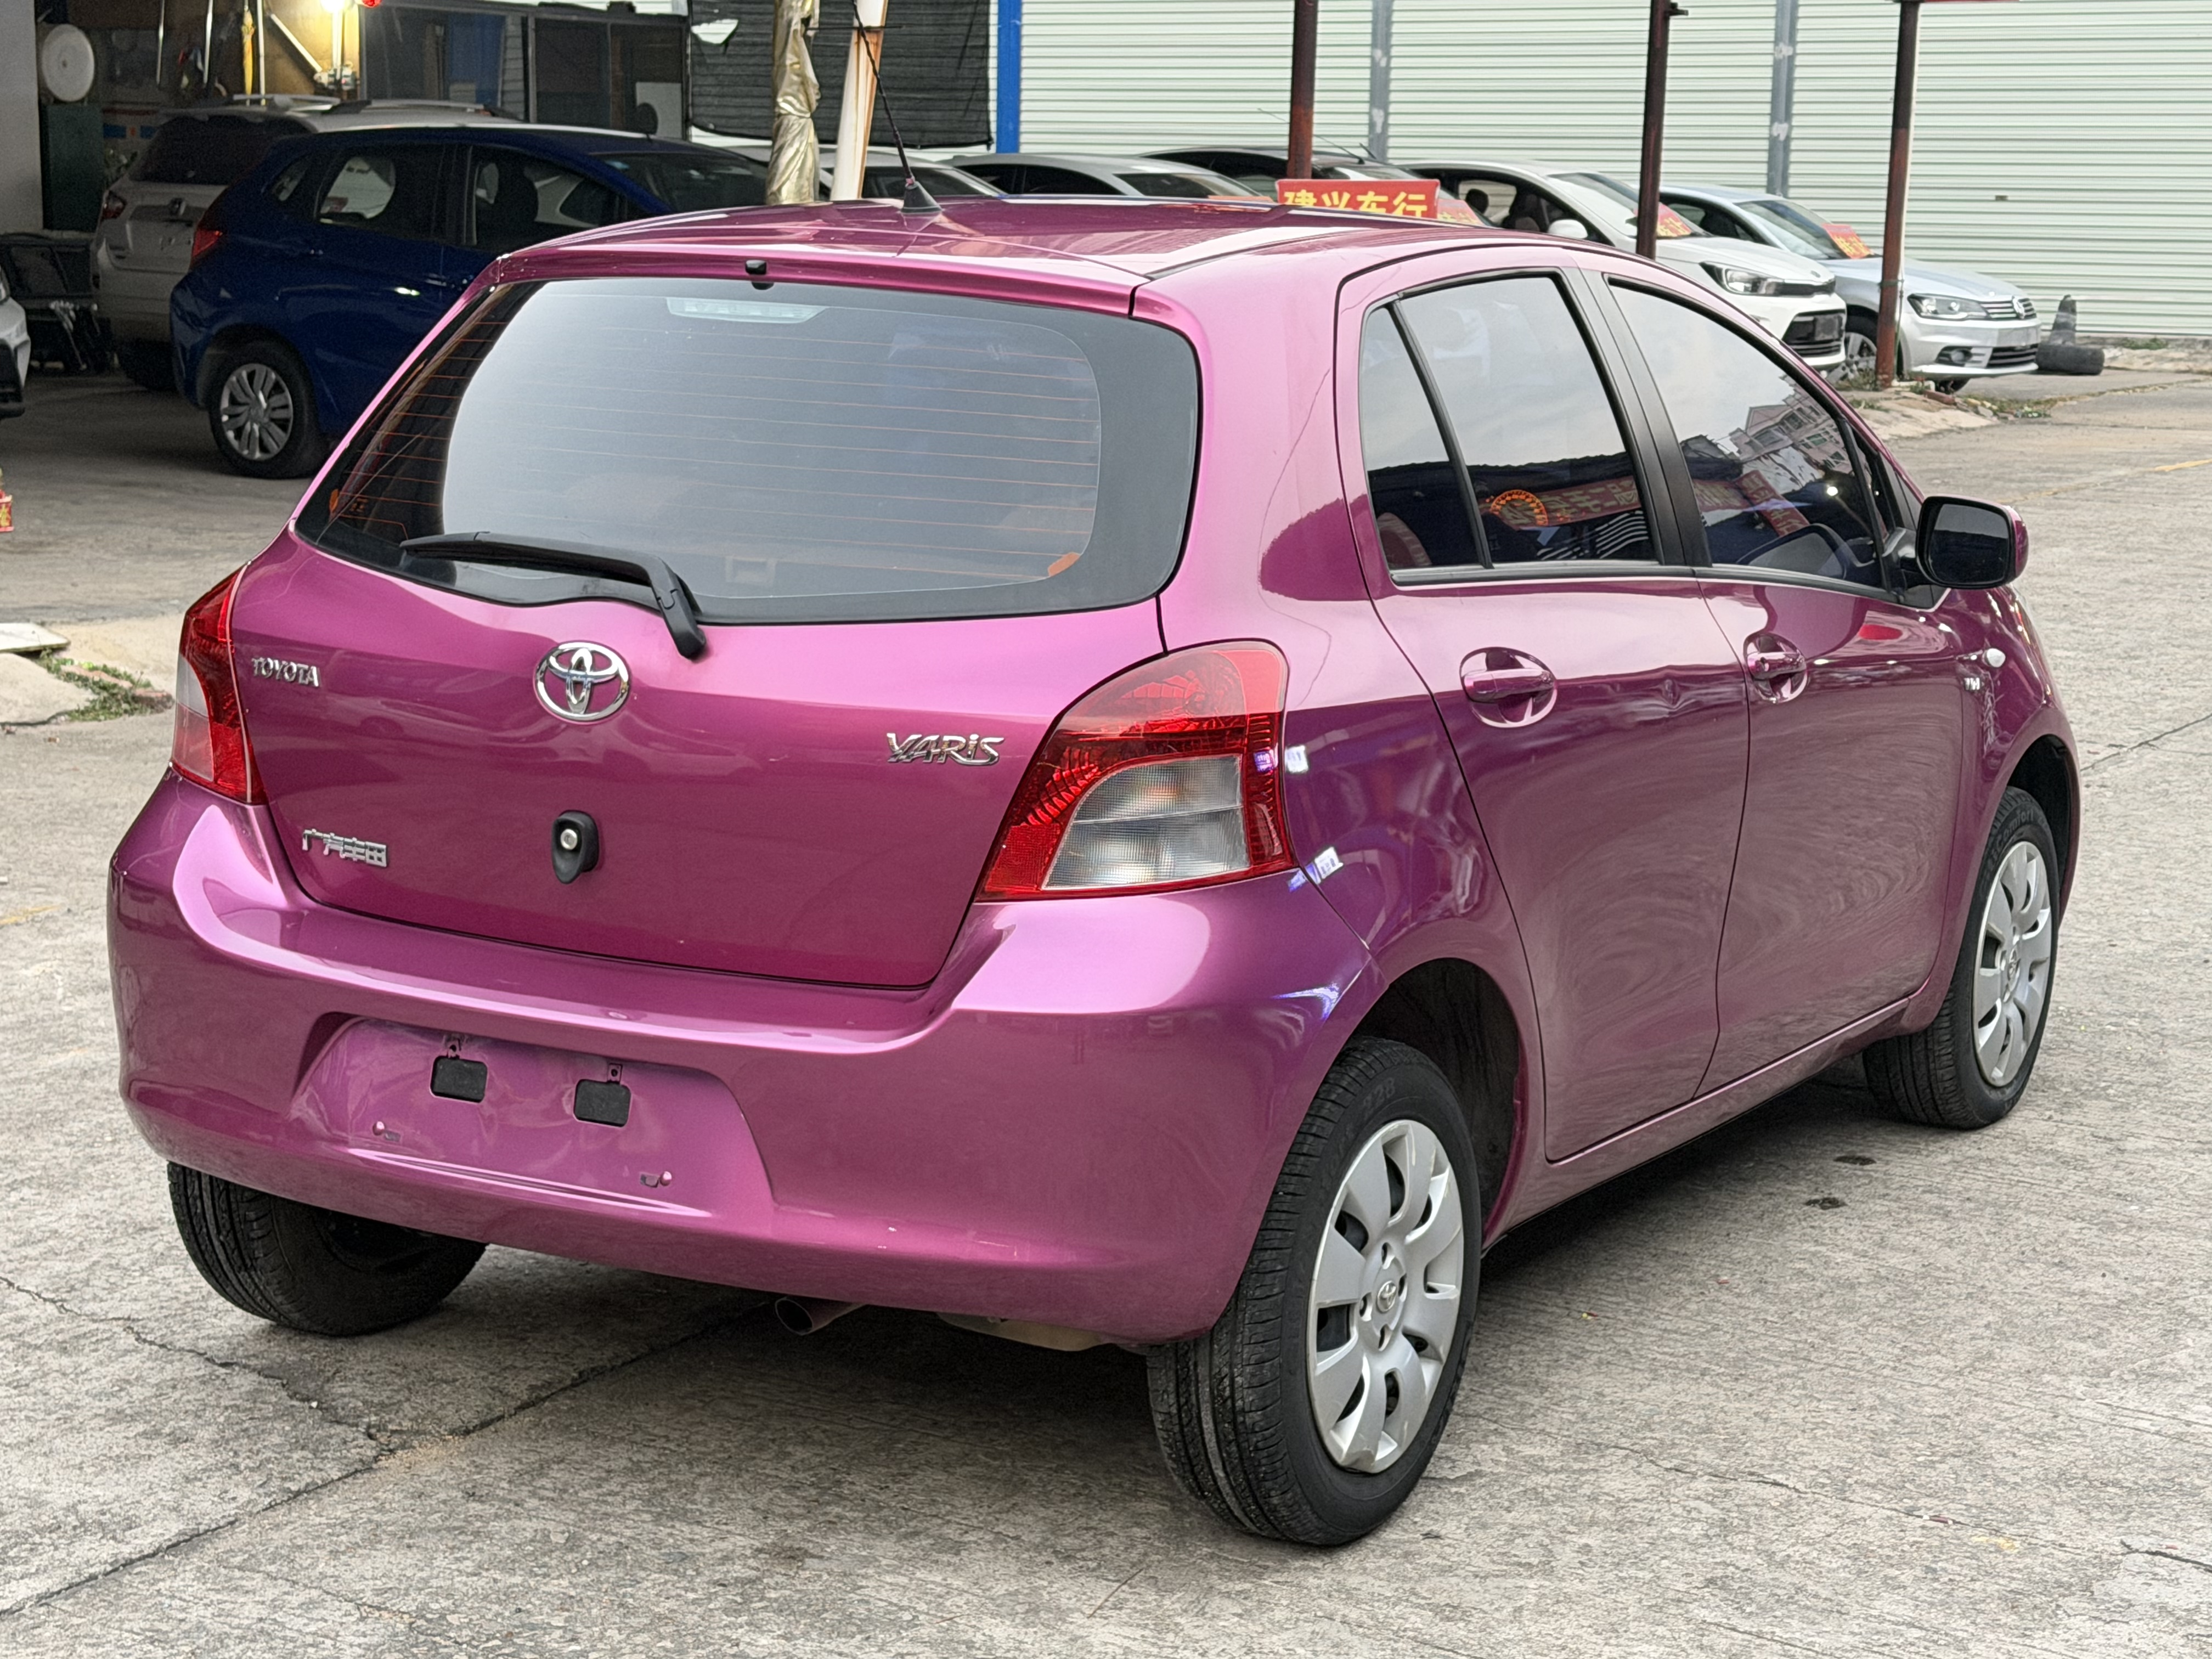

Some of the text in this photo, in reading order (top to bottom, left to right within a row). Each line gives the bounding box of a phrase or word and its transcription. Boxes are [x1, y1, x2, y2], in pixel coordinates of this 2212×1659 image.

[251, 657, 320, 687] TOYOTA
[302, 828, 387, 867] 广汽丰田
